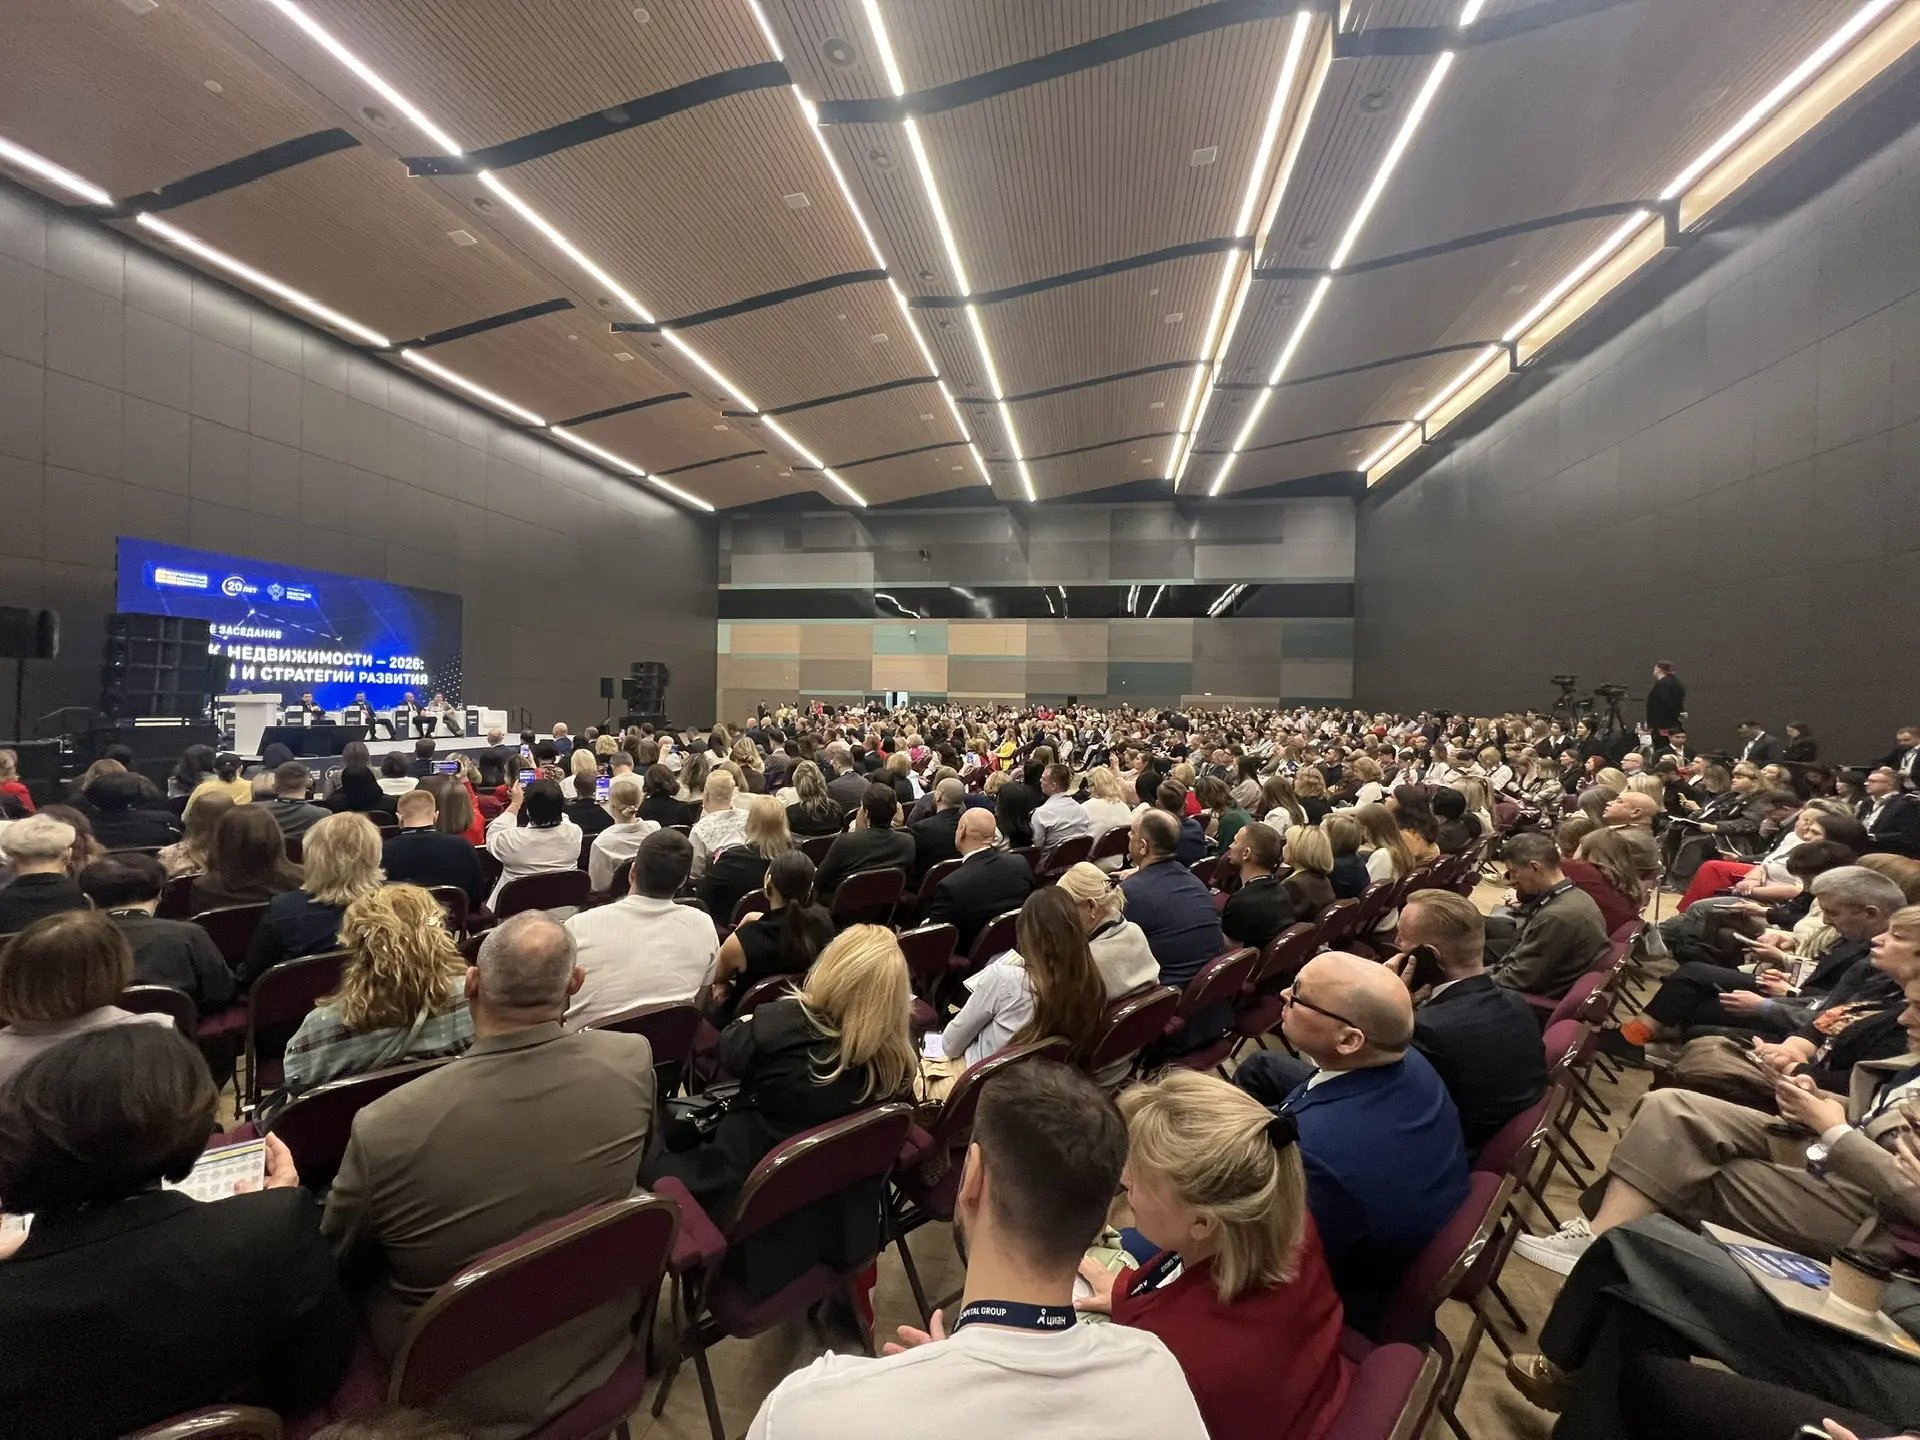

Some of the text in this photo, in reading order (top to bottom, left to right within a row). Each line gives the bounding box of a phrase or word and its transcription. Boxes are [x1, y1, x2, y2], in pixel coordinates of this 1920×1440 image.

[227, 581, 242, 592] 20
[218, 626, 282, 639] ЗАСЕДАНИЕ
[227, 644, 373, 668] НЕДВИЖИМОСТИ
[389, 656, 425, 670] 2026:
[241, 665, 256, 680] И
[260, 666, 354, 683] СТРАТЕГИИ
[358, 671, 429, 686] РАЗВИТИЯ
[980, 1306, 1007, 1316] GROUP
